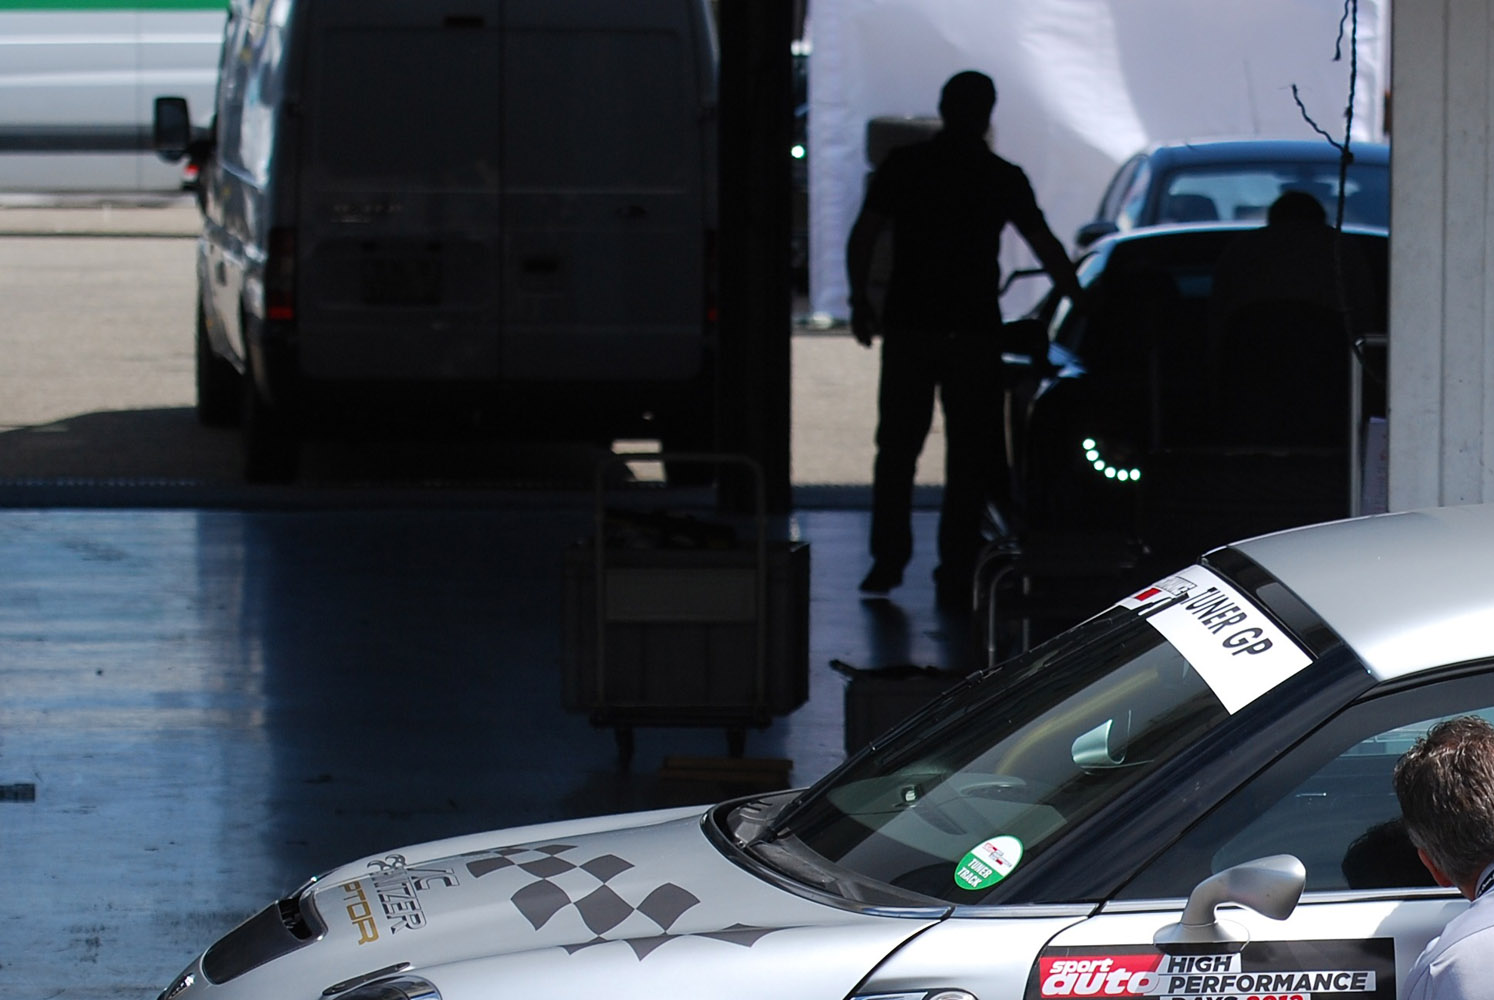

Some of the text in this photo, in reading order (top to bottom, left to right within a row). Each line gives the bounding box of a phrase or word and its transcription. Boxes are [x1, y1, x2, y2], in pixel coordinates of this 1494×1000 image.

[1180, 587, 1247, 635] TUNER
[1222, 627, 1273, 656] GP
[957, 866, 982, 888] TRACK
[968, 858, 993, 879] TUNER
[339, 880, 380, 946] PTOR
[1049, 958, 1114, 974] sport
[1168, 955, 1232, 973] HIGH
[1042, 970, 1159, 996] auto
[1168, 972, 1368, 994] PERFORMANCE
